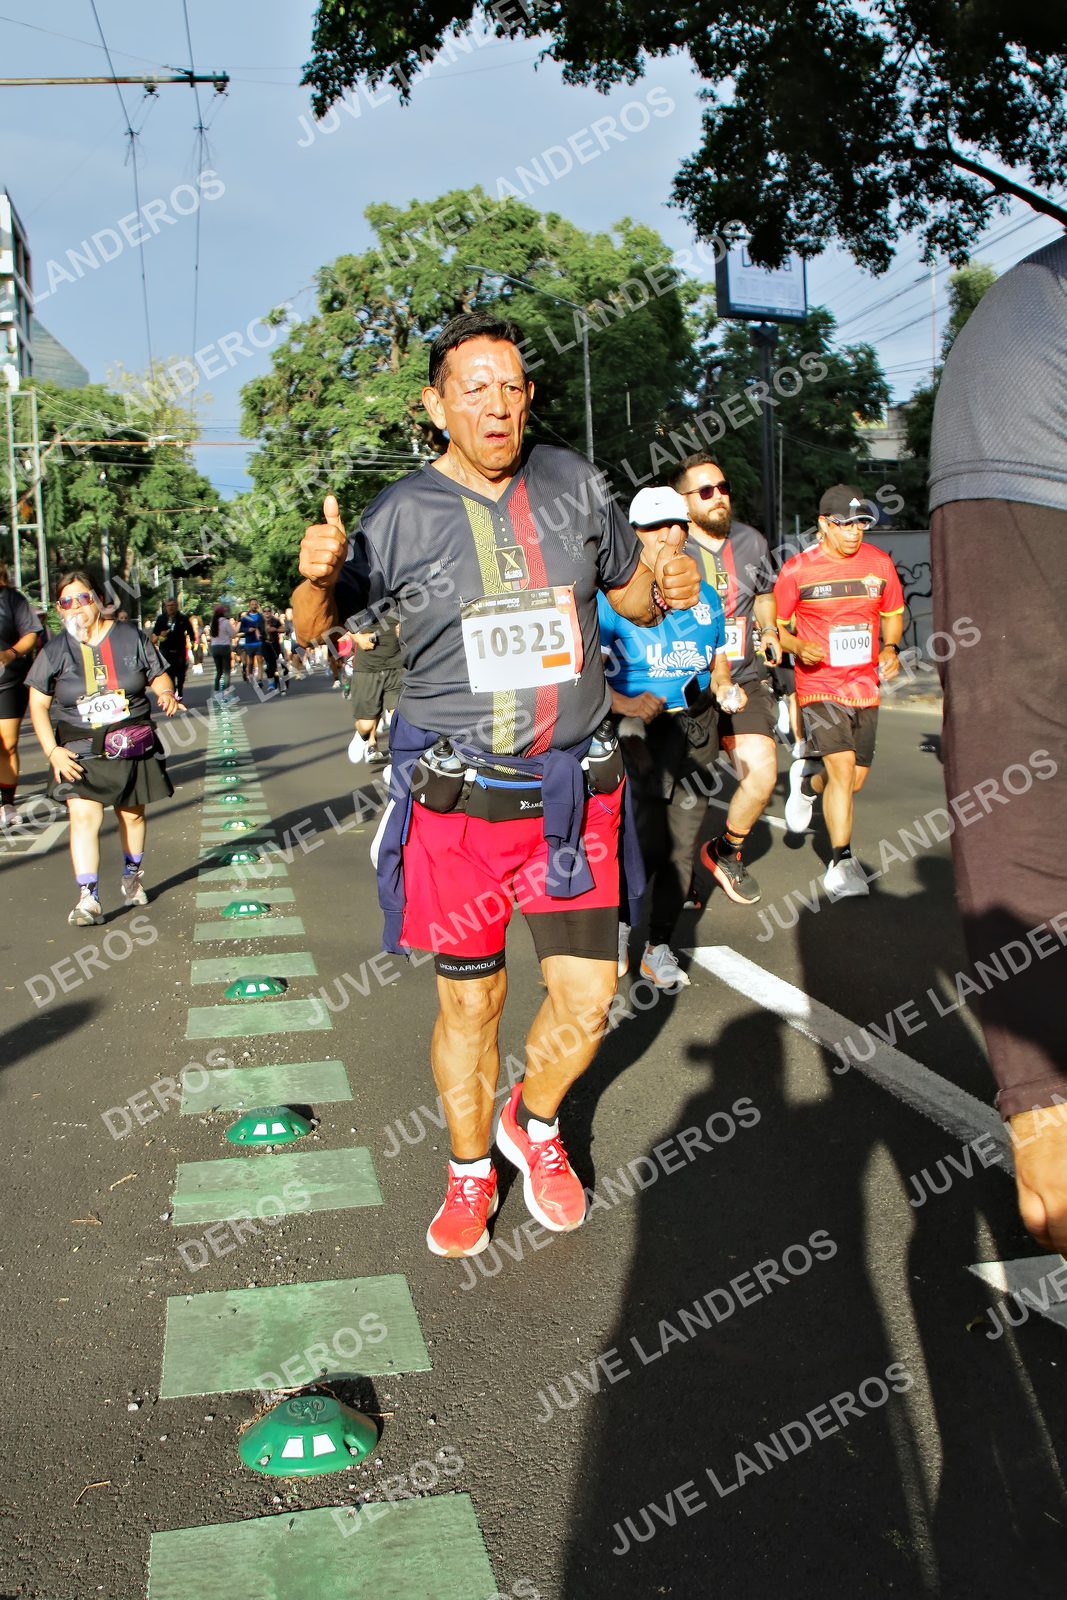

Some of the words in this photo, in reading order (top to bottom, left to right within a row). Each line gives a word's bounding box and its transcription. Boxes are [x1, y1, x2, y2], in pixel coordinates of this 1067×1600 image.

[470, 620, 565, 659] 10325
[834, 636, 870, 651] 10090
[646, 643, 662, 665] U
[672, 640, 698, 651] DE
